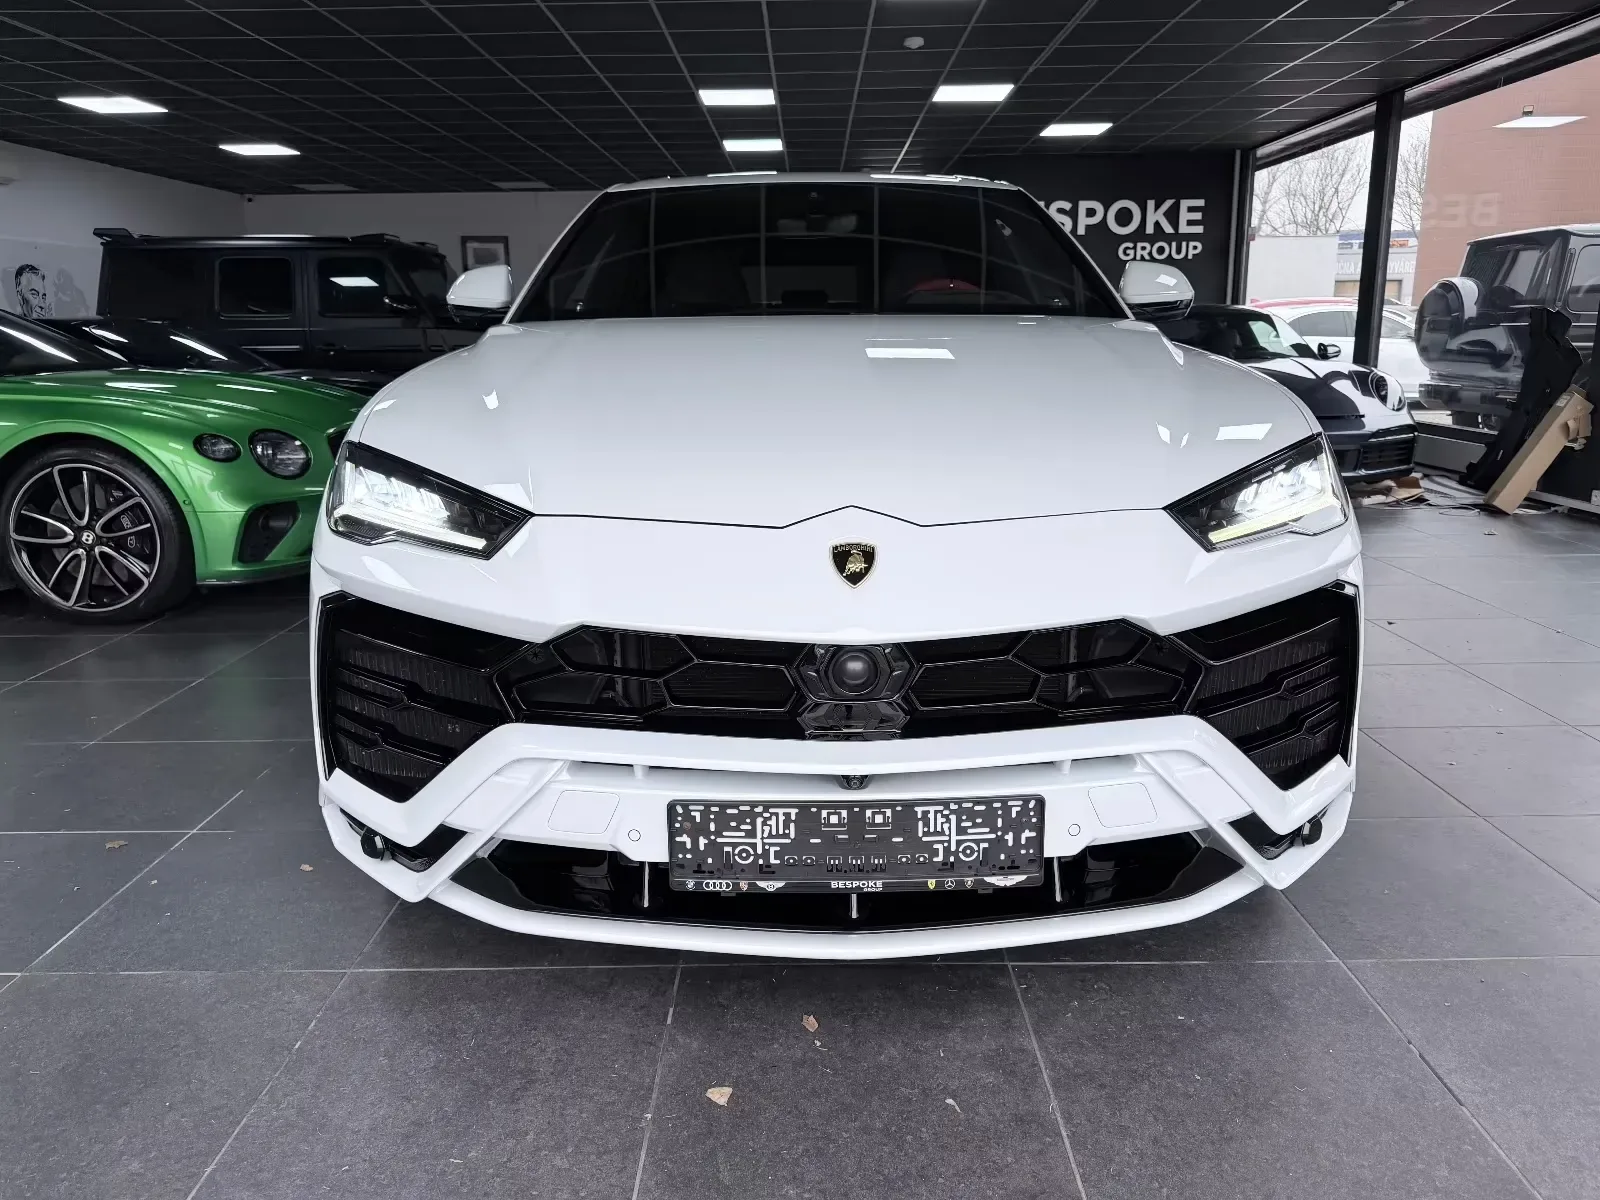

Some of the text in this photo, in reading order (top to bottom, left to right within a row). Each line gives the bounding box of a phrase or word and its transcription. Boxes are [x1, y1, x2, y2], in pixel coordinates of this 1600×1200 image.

[1038, 199, 1205, 235] SPOKE
[1117, 241, 1203, 261] GROUP
[831, 880, 883, 889] BESPOKE
